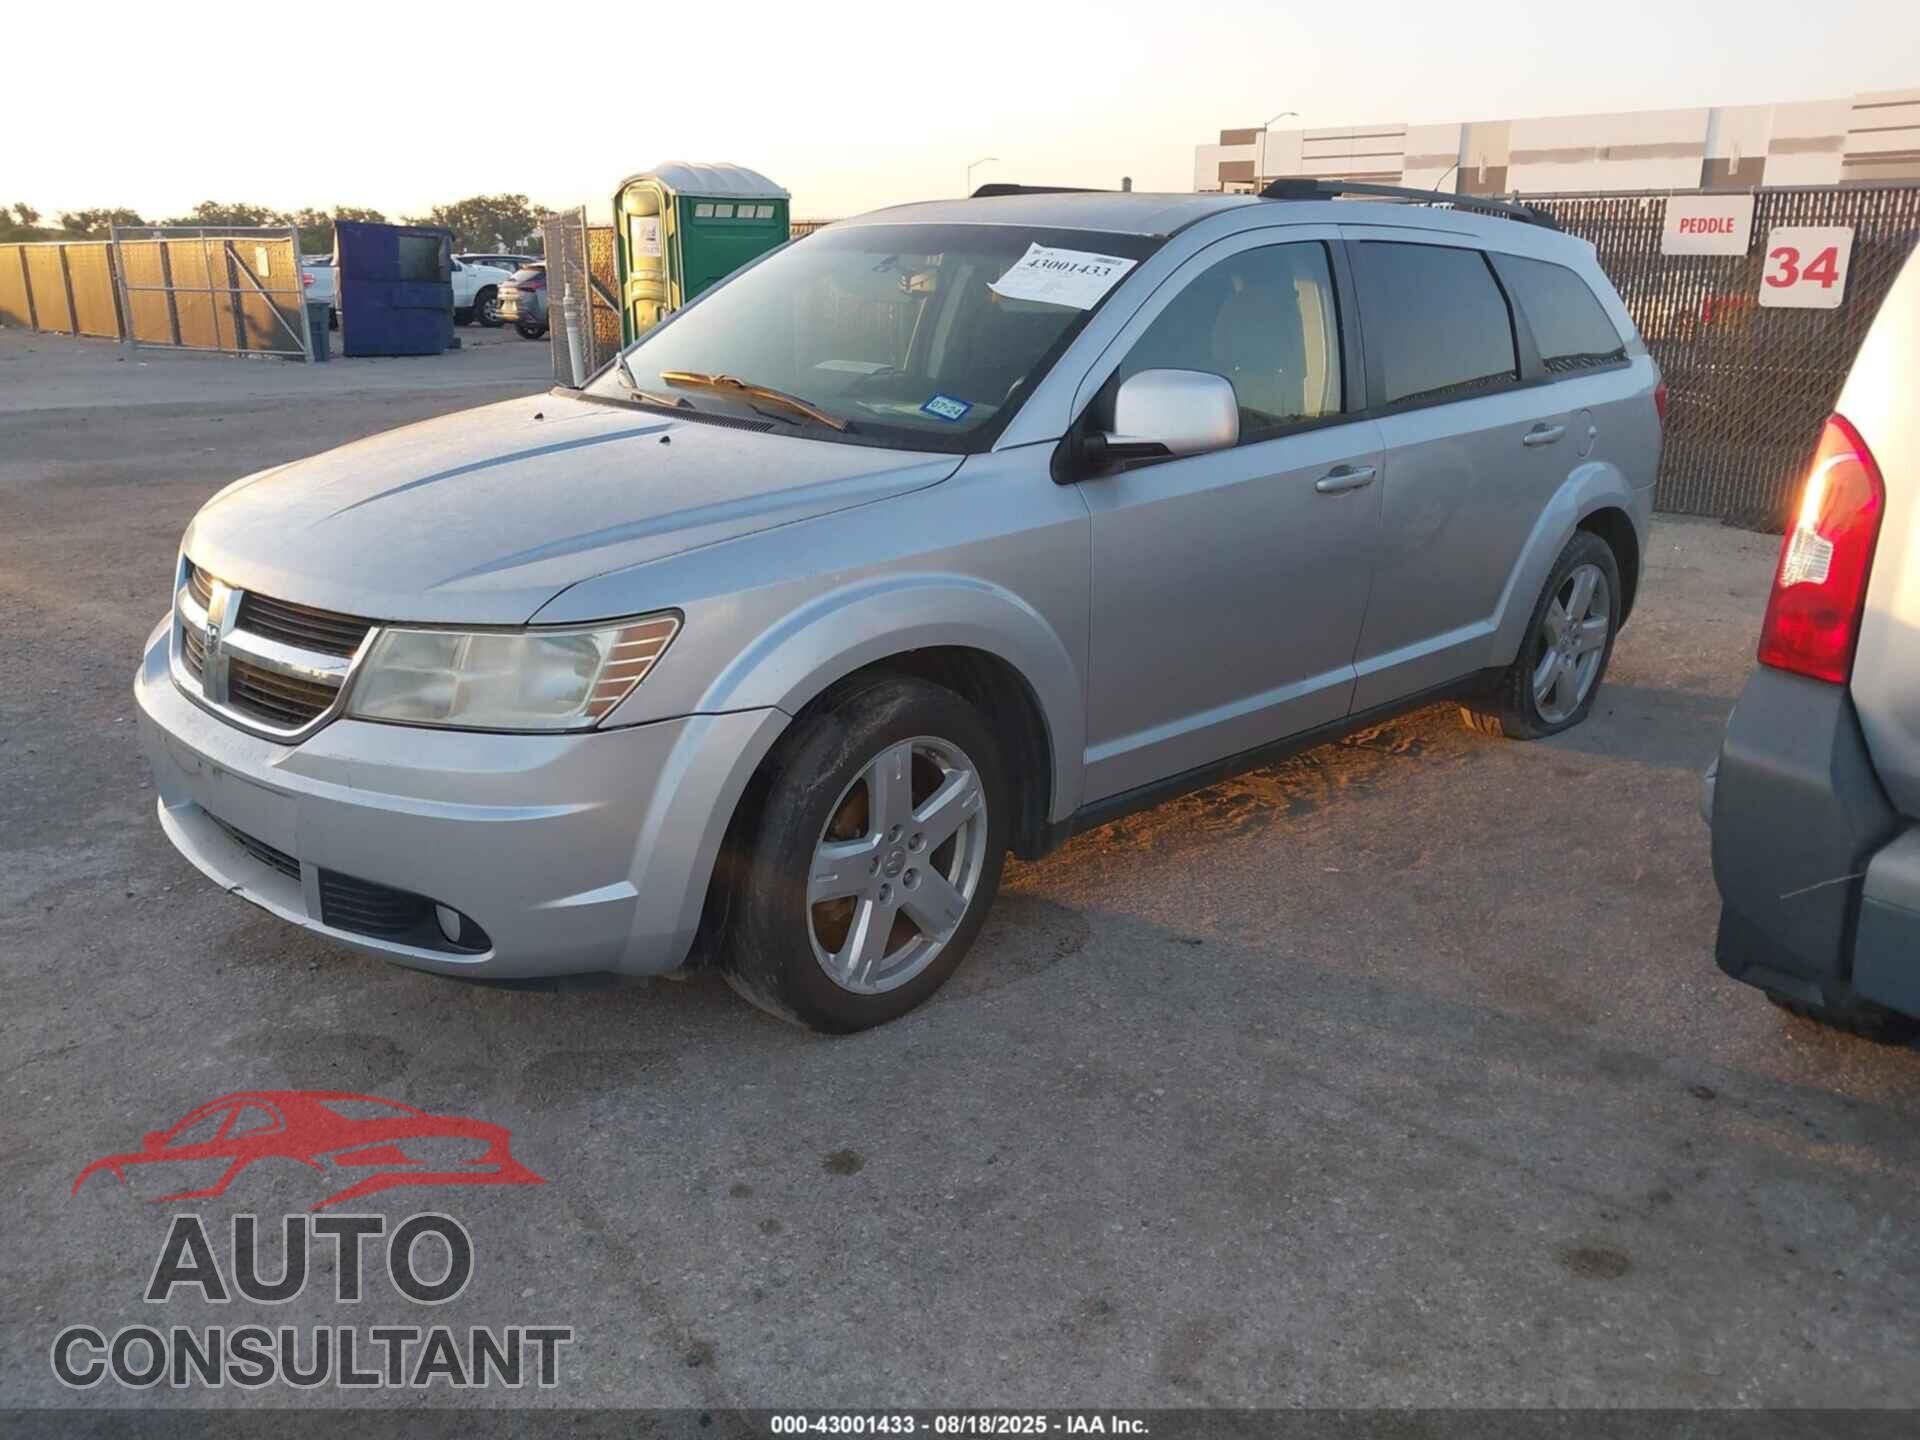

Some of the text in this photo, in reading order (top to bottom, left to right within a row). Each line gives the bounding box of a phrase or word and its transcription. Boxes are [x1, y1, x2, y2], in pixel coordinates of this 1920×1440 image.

[1679, 217, 1735, 234] PEDDLE
[1026, 258, 1112, 278] 43001433
[1765, 246, 1839, 289] 34
